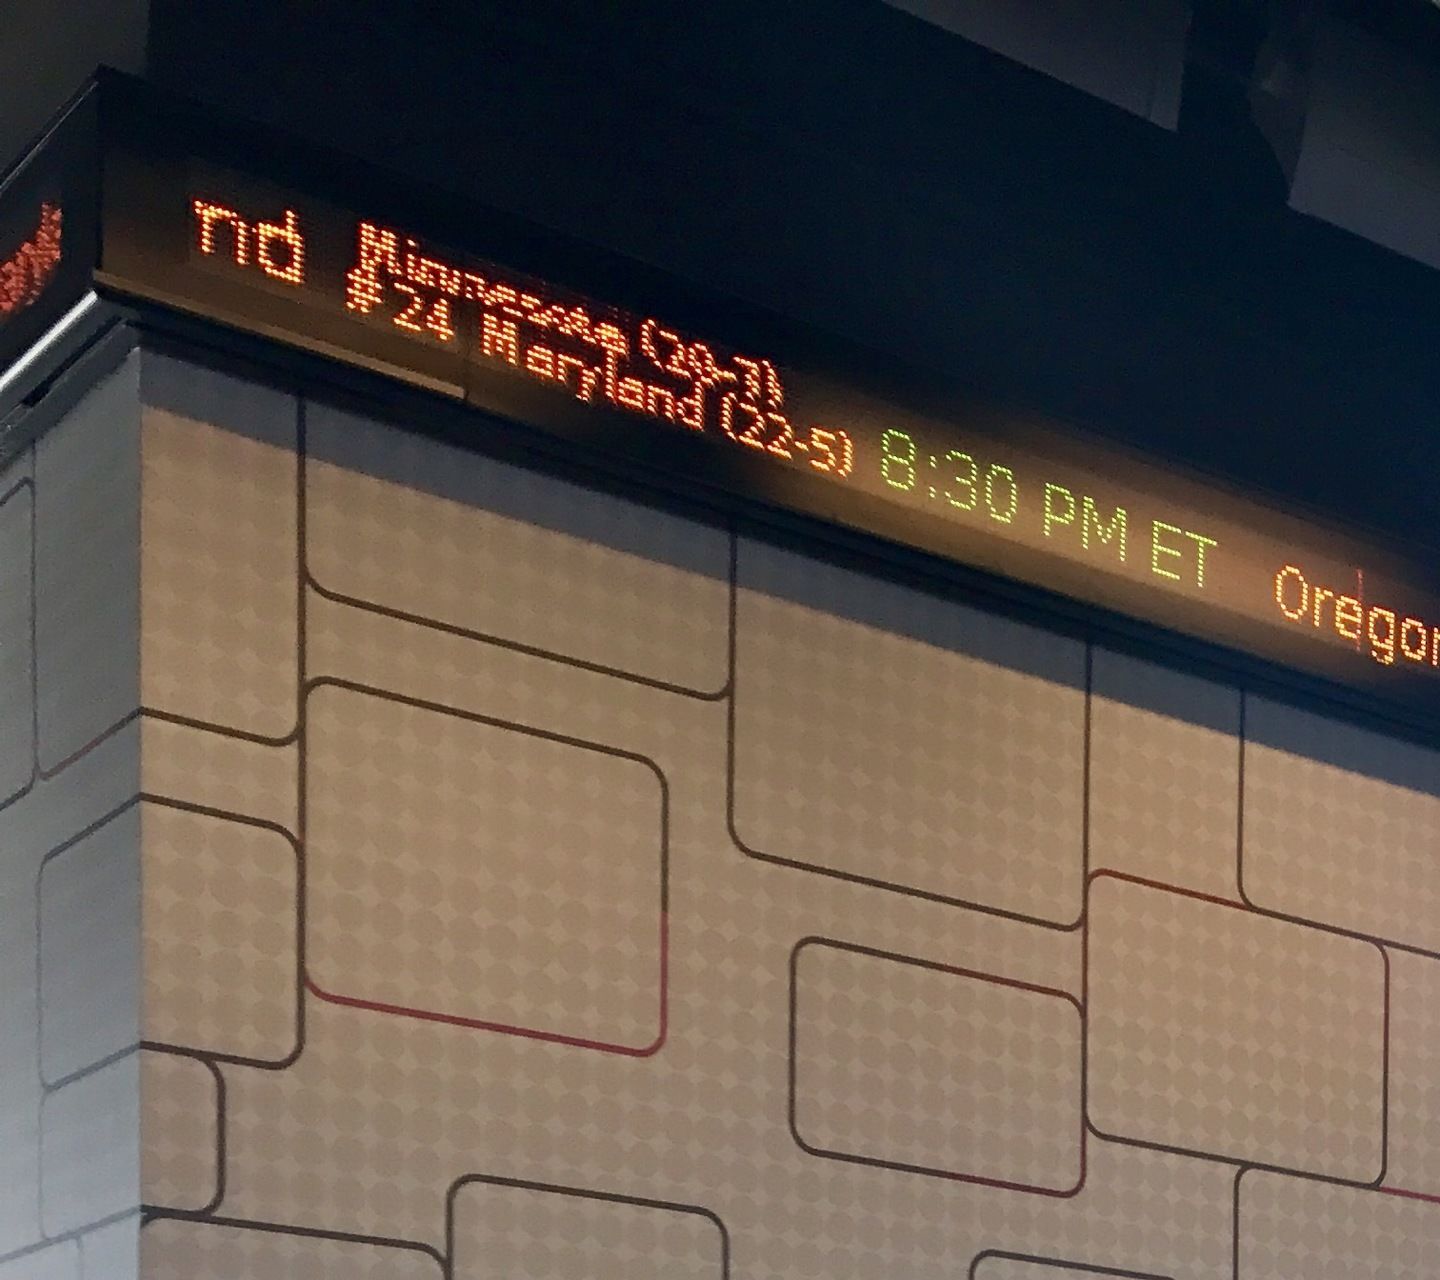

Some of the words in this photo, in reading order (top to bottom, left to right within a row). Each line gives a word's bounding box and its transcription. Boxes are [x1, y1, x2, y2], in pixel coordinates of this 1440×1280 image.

[345, 268, 455, 342] #24
[483, 312, 704, 432] Maryland
[722, 392, 853, 477] (22-5)
[880, 428, 1018, 525] 8:30
[1043, 481, 1128, 562] PM
[1152, 519, 1218, 588] ET
